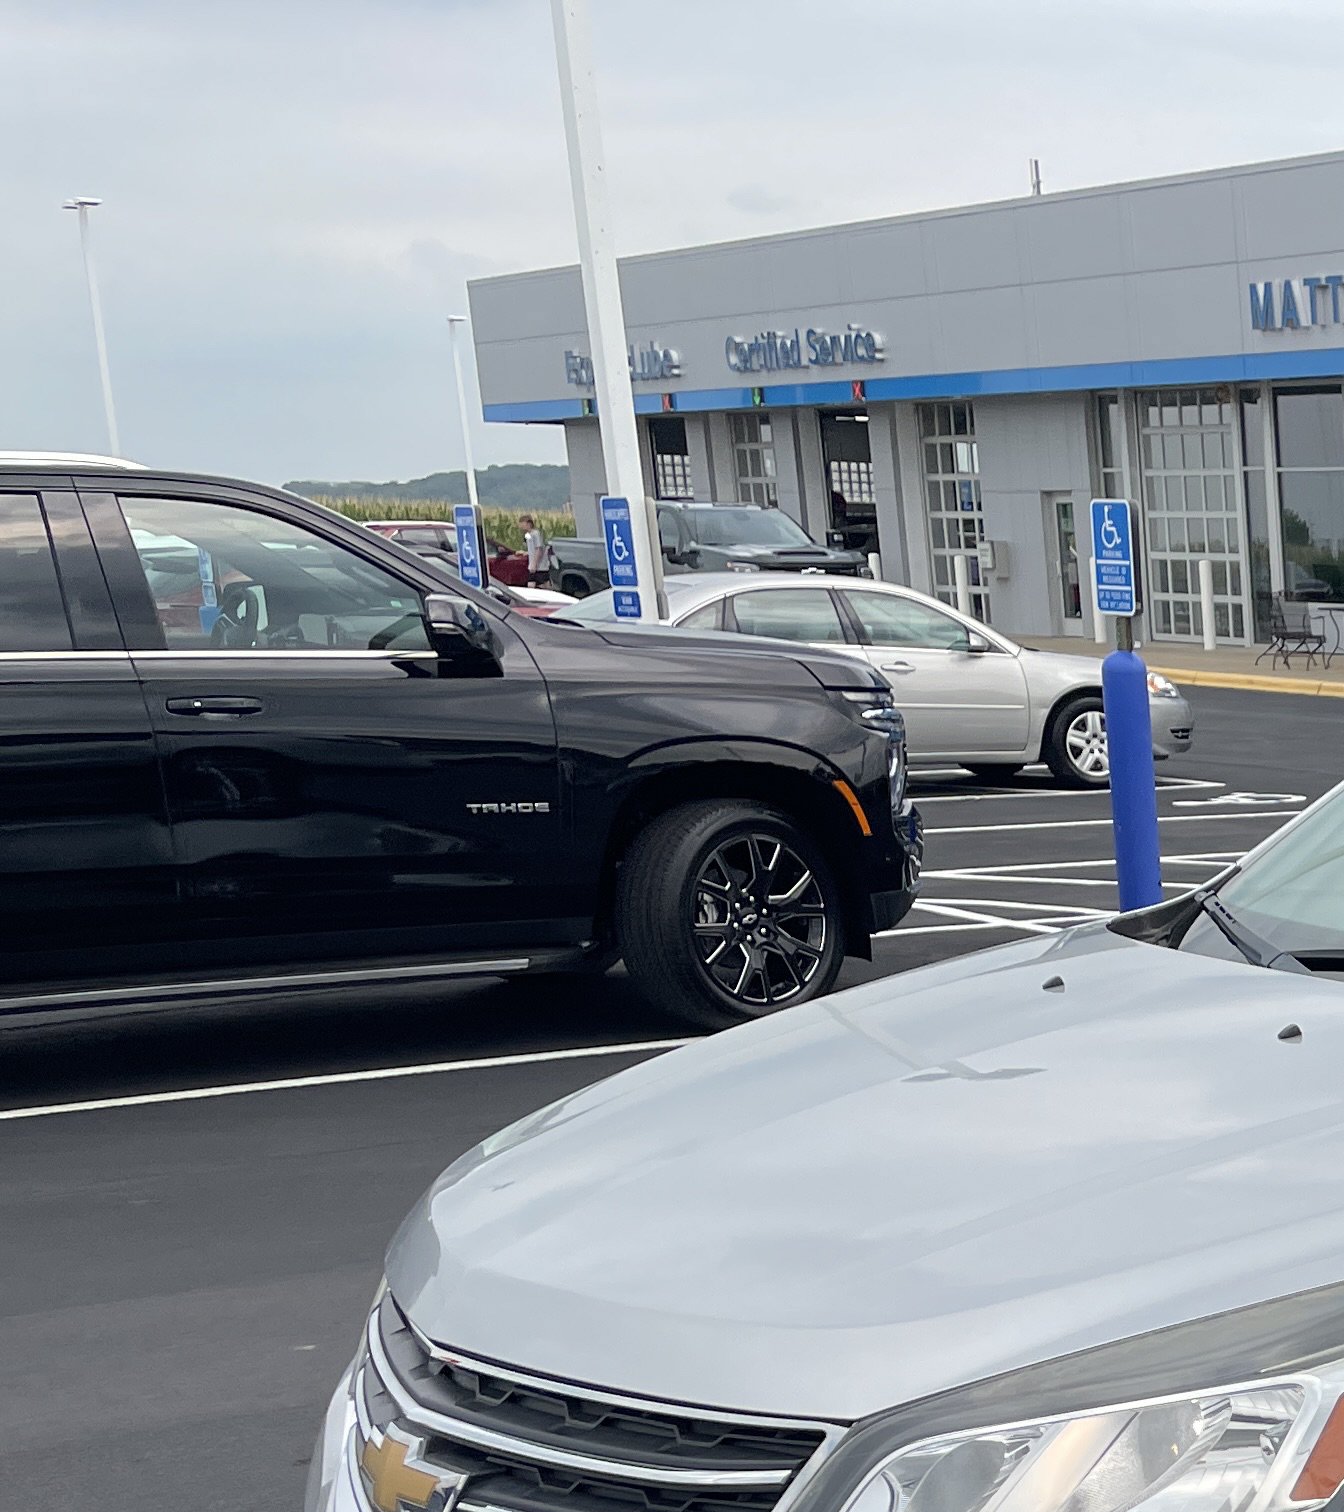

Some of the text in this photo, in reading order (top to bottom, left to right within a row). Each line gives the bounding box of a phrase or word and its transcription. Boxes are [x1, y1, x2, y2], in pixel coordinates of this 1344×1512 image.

[628, 340, 674, 382] Lube
[725, 323, 878, 372] Certified Service
[466, 802, 550, 814] TAHOE
